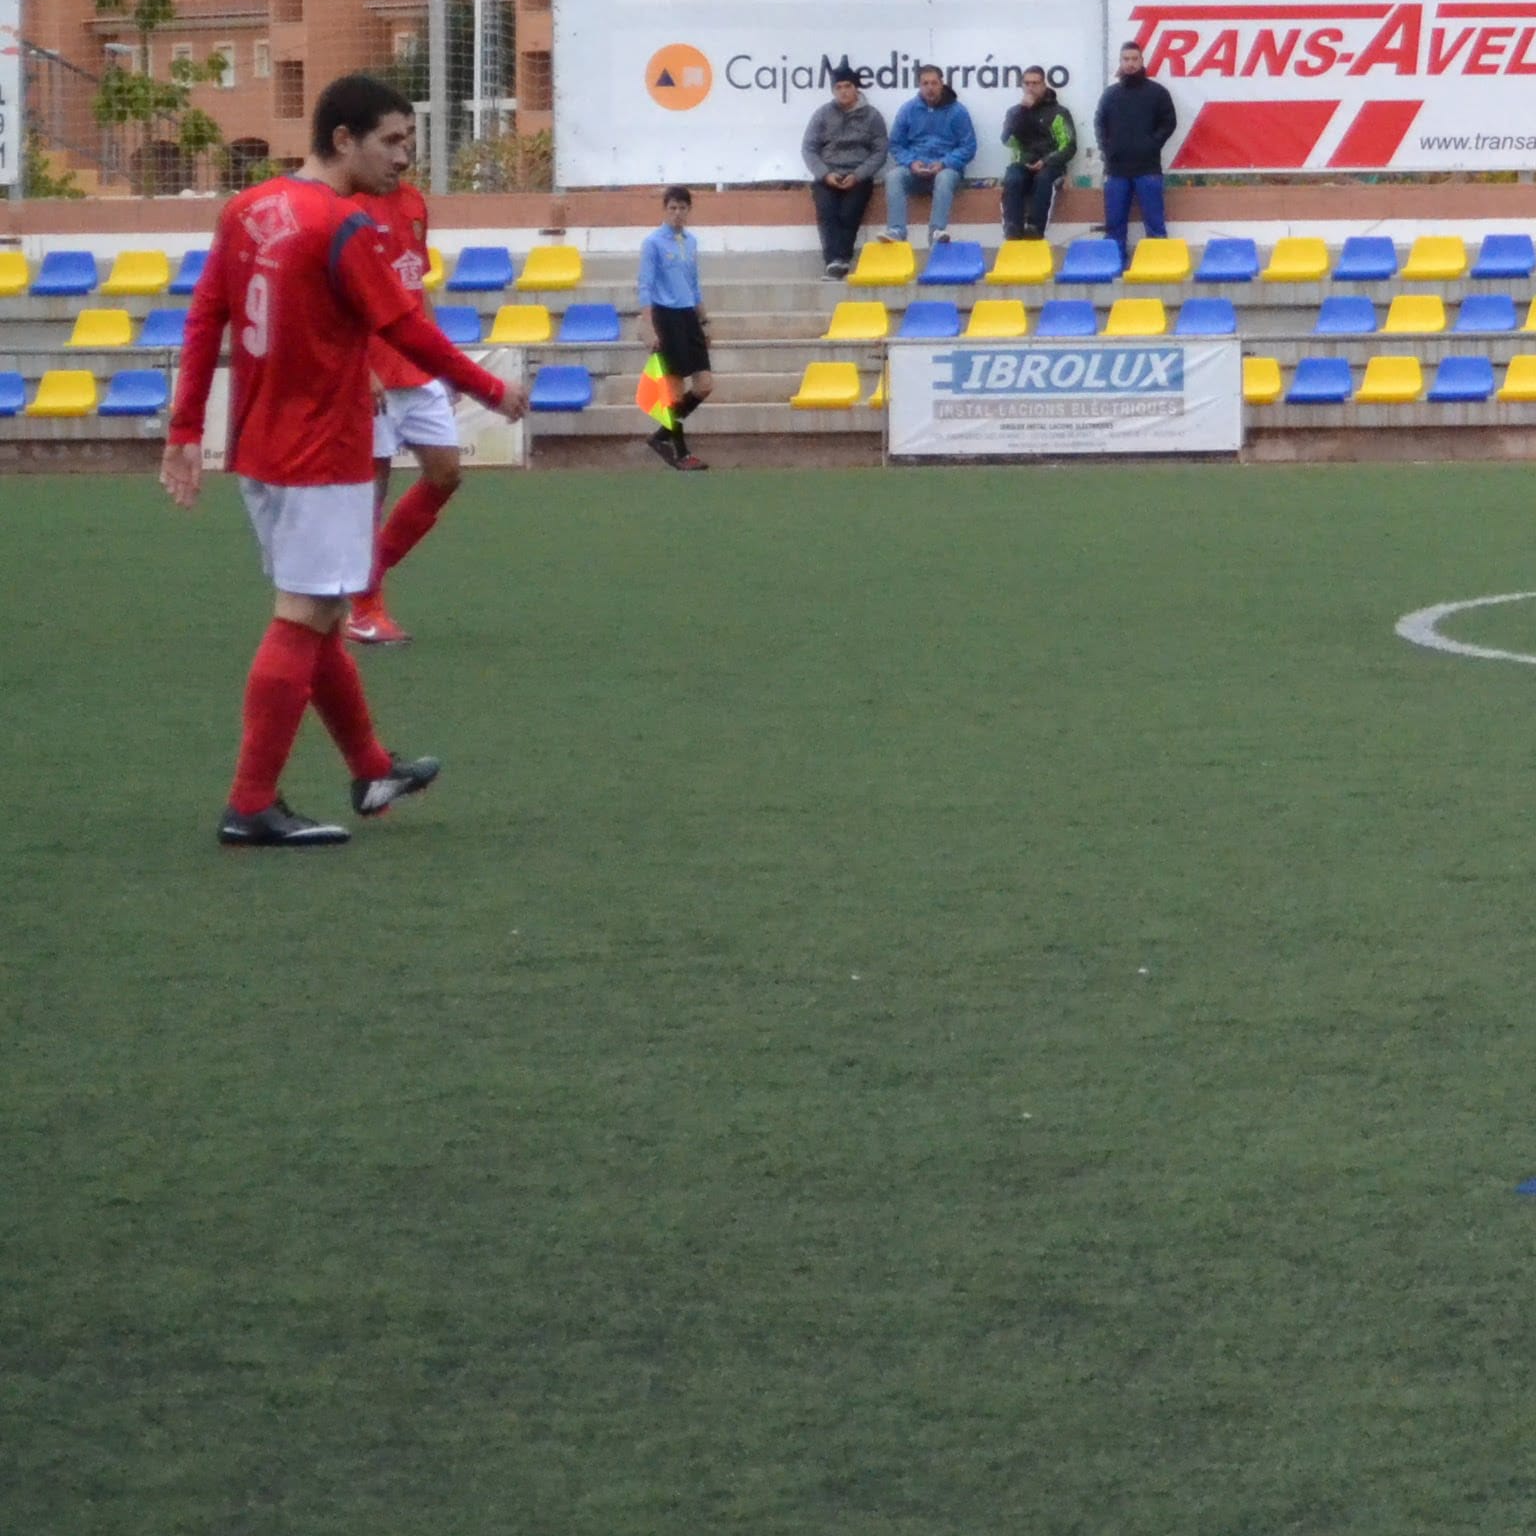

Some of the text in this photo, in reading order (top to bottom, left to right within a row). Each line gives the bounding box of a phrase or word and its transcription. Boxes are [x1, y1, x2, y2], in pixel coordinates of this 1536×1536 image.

[724, 51, 1070, 103] CajaMeditrráno
[242, 272, 269, 358] 9
[961, 351, 1179, 390] IBROLUX
